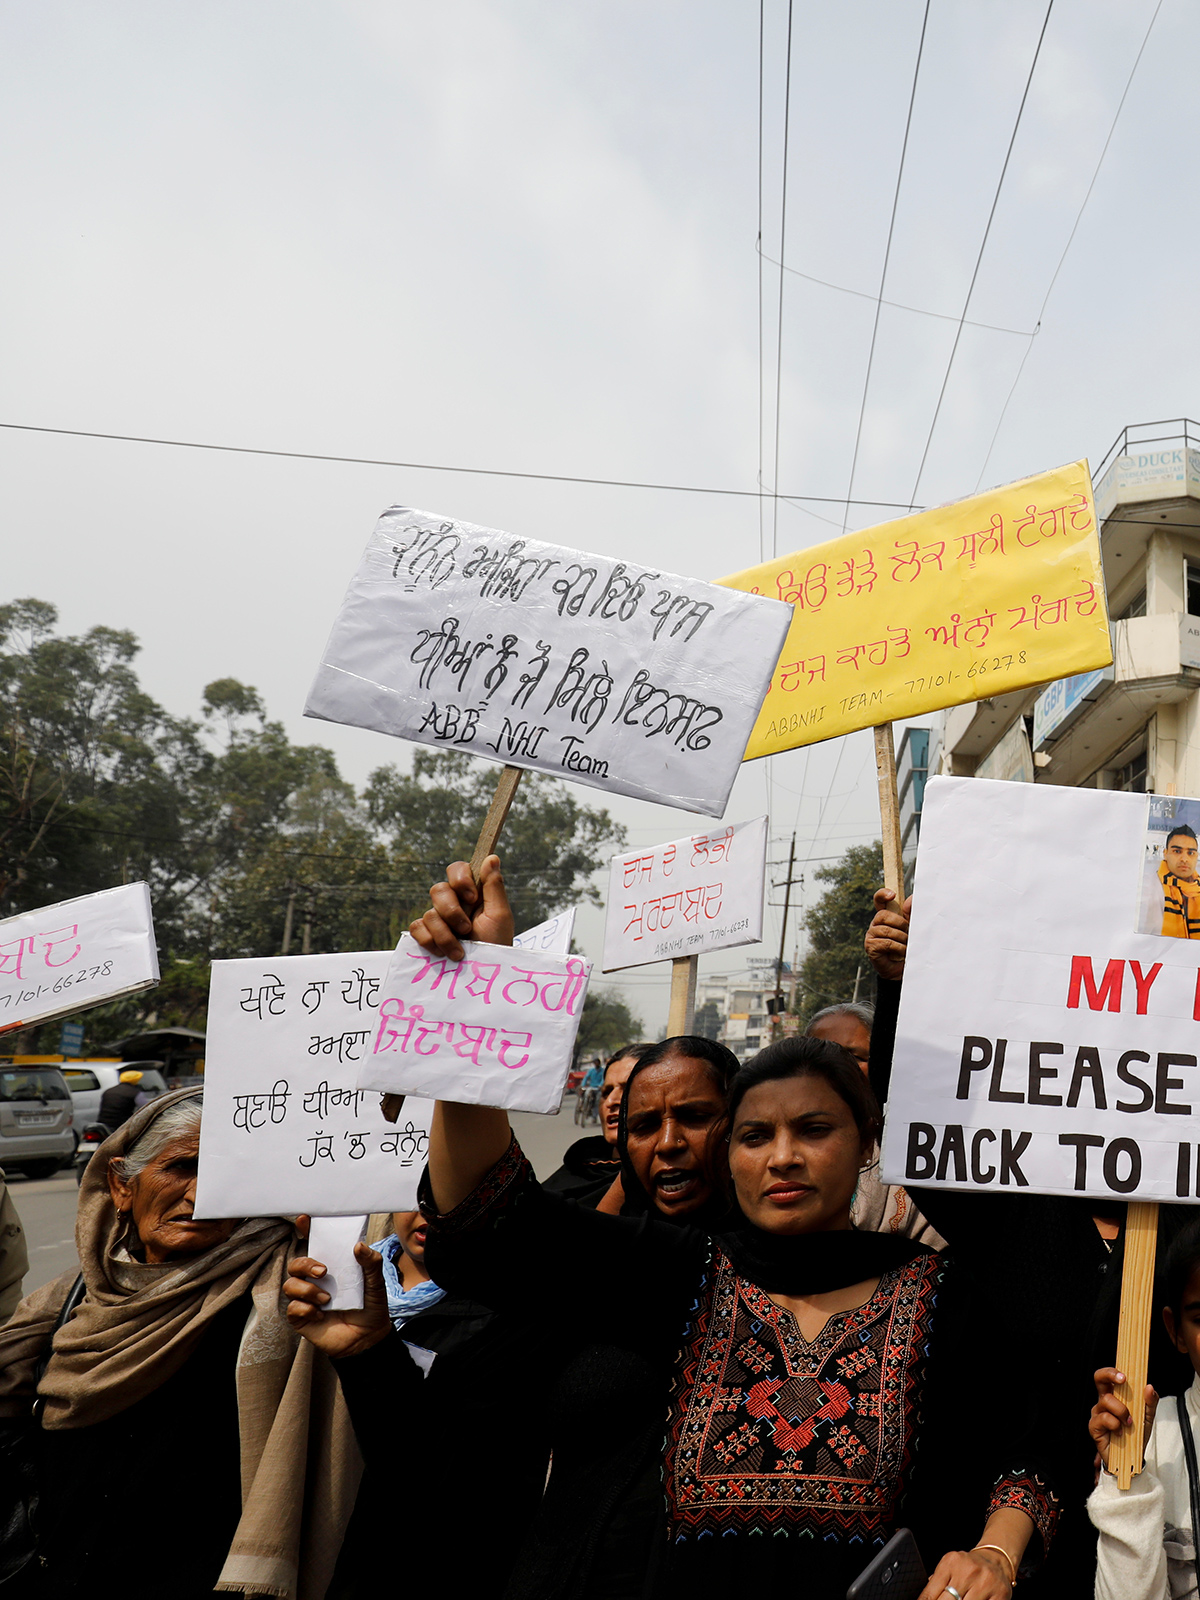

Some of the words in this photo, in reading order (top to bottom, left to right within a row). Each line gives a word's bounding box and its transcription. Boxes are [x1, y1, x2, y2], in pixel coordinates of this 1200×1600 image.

[1138, 450, 1184, 468] DUCK
[888, 541, 946, 582] ਲੋਕ
[765, 705, 827, 740] ABBNHI
[904, 650, 1028, 694] 77101-66278
[1043, 679, 1064, 717] GBP
[418, 701, 480, 744] ABB
[486, 717, 549, 759] NHI
[560, 736, 609, 779] Team
[623, 855, 655, 889] ਦਾਜ
[662, 844, 677, 877] ਦੇ
[622, 883, 723, 941] ਮੁਰਦਾਬਾਦ
[686, 934, 704, 947] TEAM
[302, 981, 330, 1014] ਨਾ
[1066, 955, 1163, 1015] MY
[956, 1036, 1197, 1116] PLEASE
[905, 1122, 1033, 1187] BACK
[1059, 1133, 1142, 1193] TO
